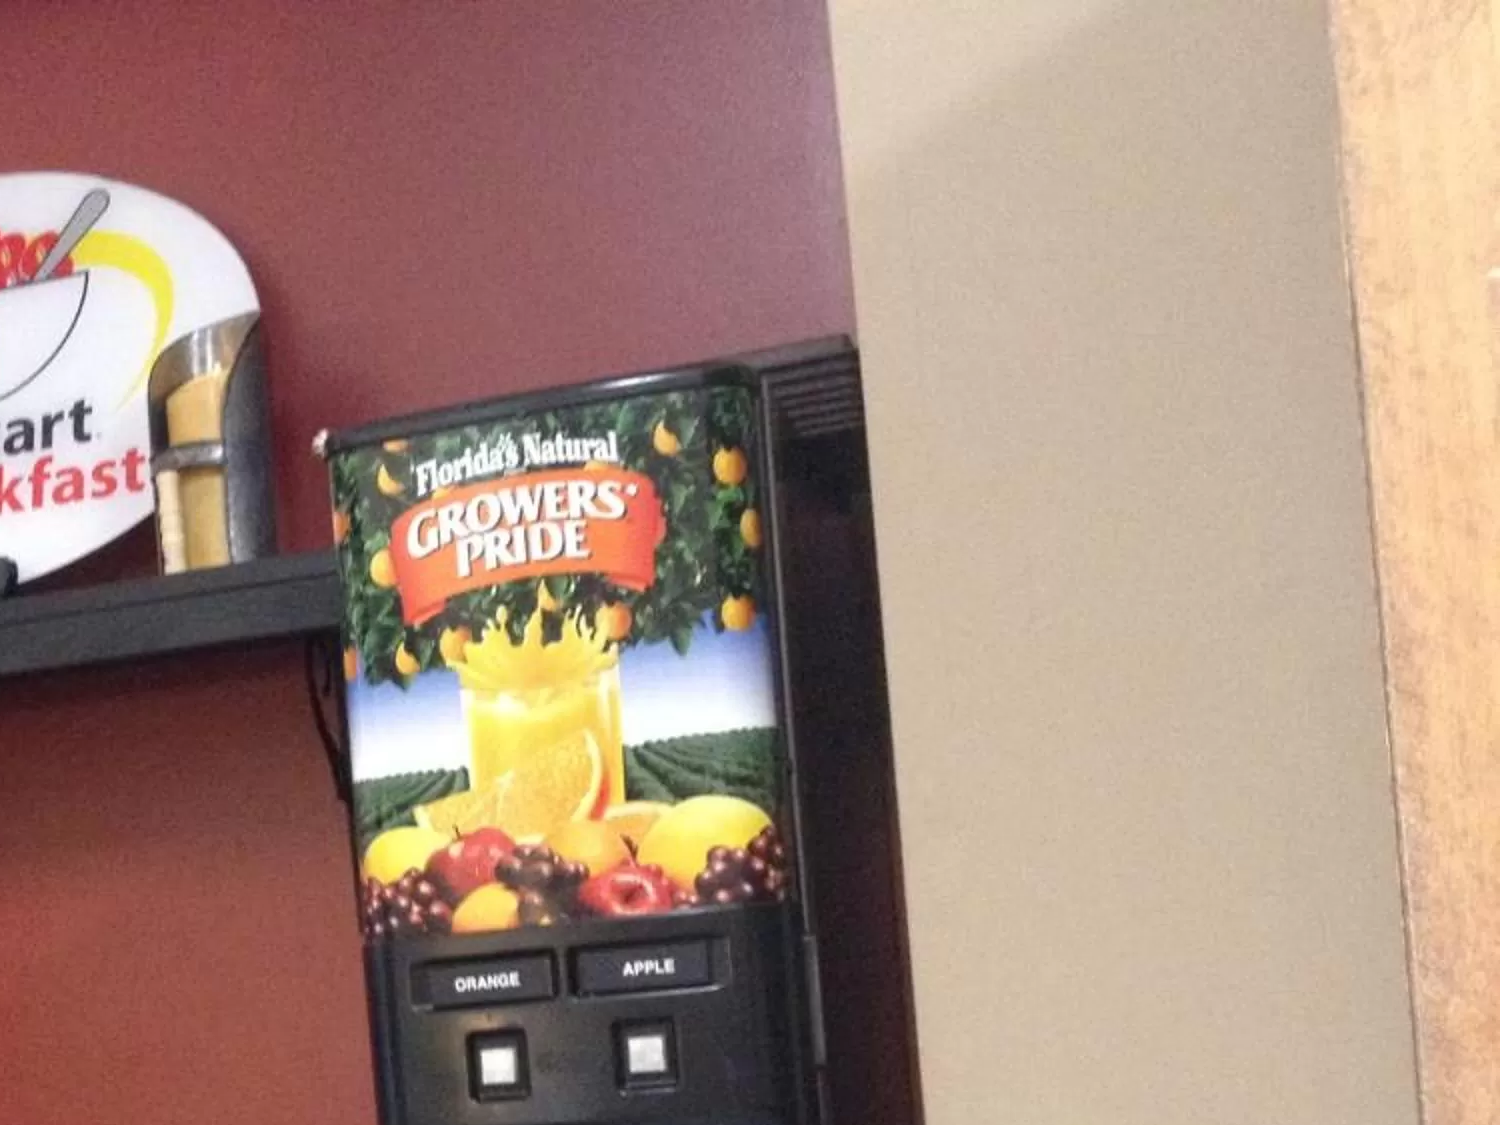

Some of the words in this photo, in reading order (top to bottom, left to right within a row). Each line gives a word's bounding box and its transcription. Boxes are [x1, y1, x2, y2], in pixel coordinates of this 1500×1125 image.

[416, 432, 520, 497] Florida's
[522, 430, 619, 466] Natural
[456, 519, 592, 578] PRIDE
[454, 971, 522, 994] ORANGE
[622, 957, 676, 978] APPLE
